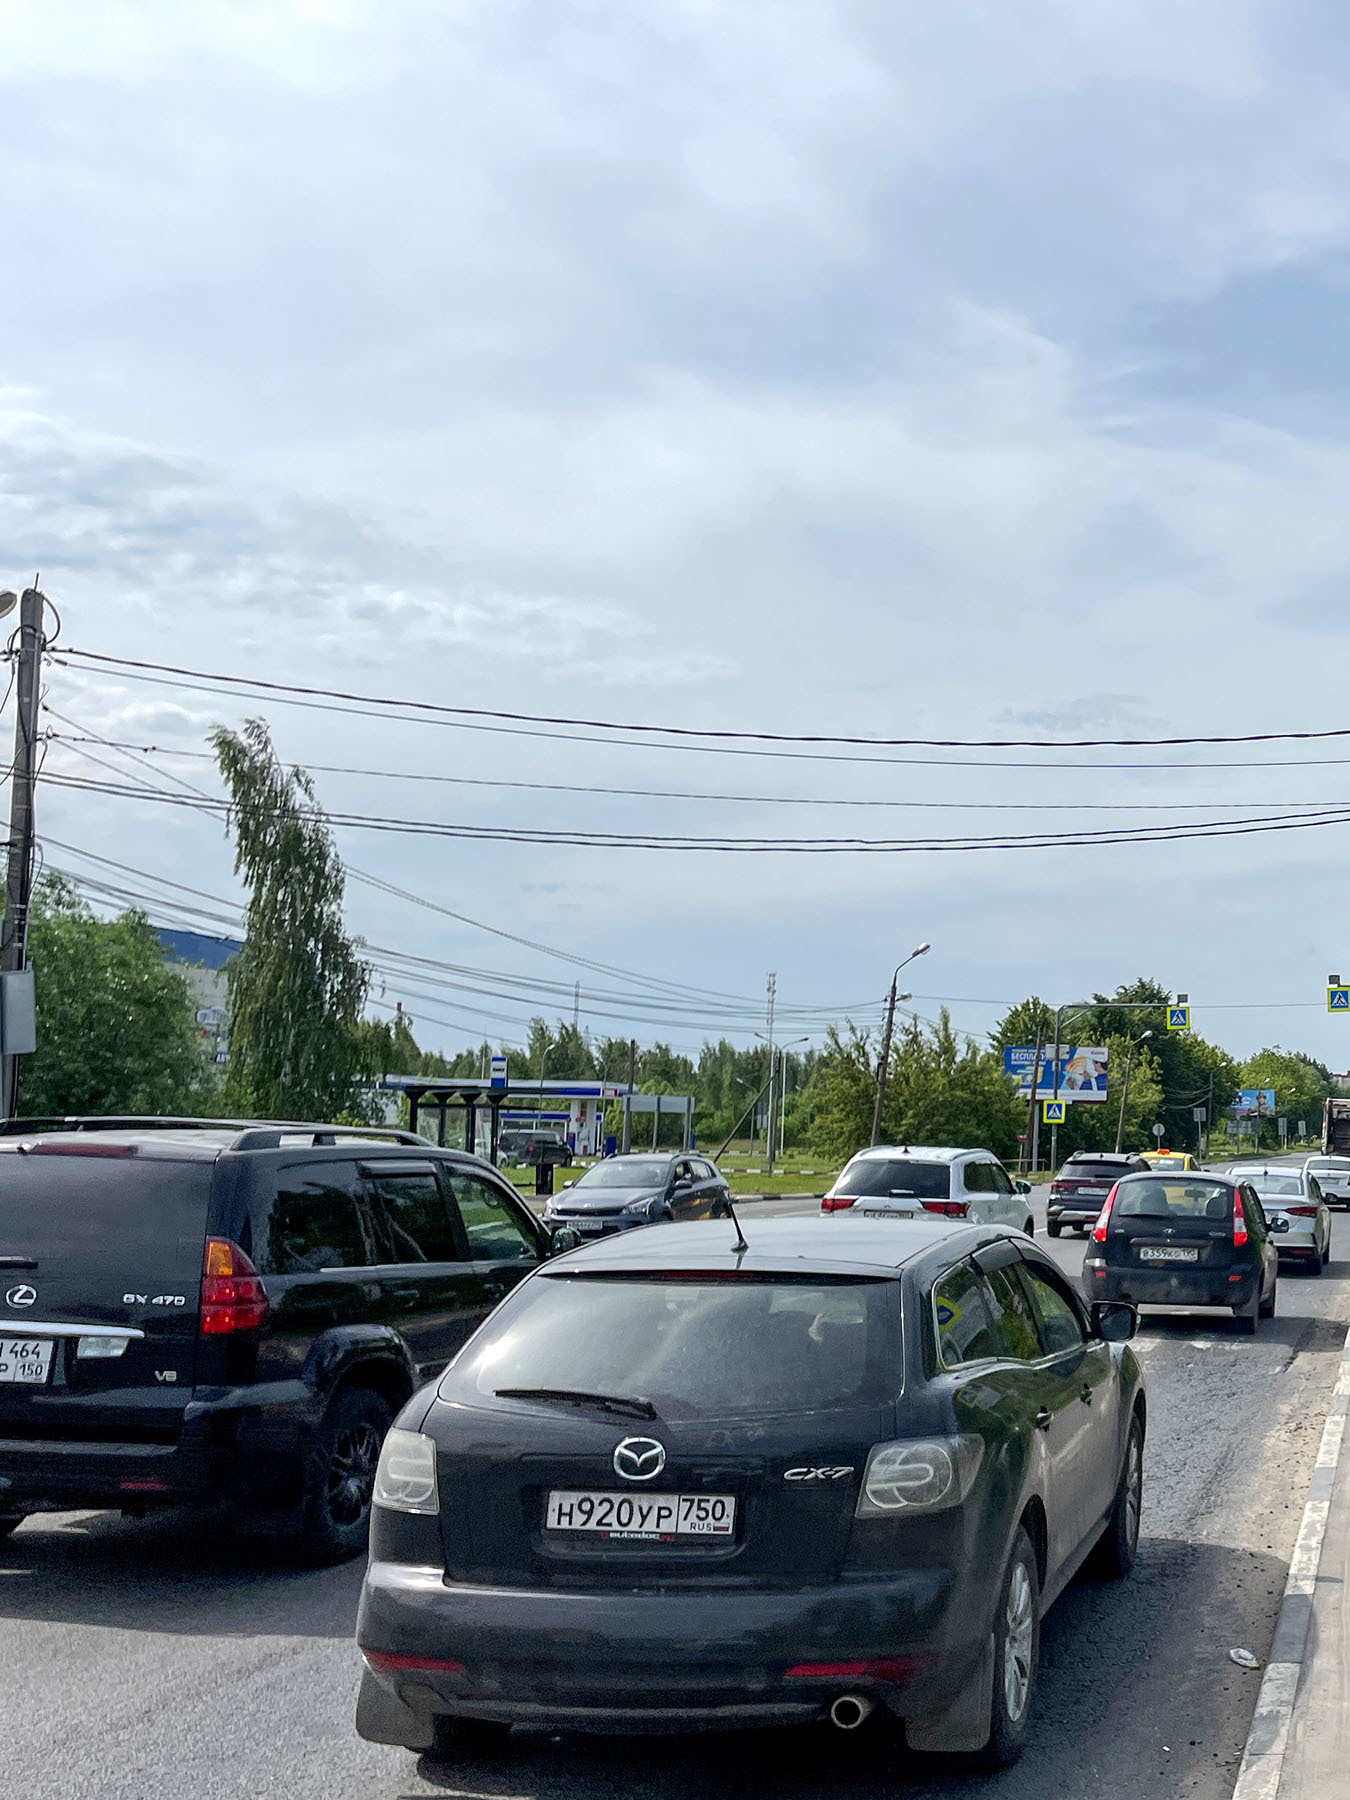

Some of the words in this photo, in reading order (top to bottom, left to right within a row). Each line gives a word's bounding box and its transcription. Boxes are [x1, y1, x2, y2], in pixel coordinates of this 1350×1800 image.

[152, 1295, 186, 1306] 470
[19, 1363, 43, 1376] 150
[783, 1466, 855, 1480] CX-7
[681, 1498, 726, 1521] 750
[690, 1521, 712, 1532] RUS
